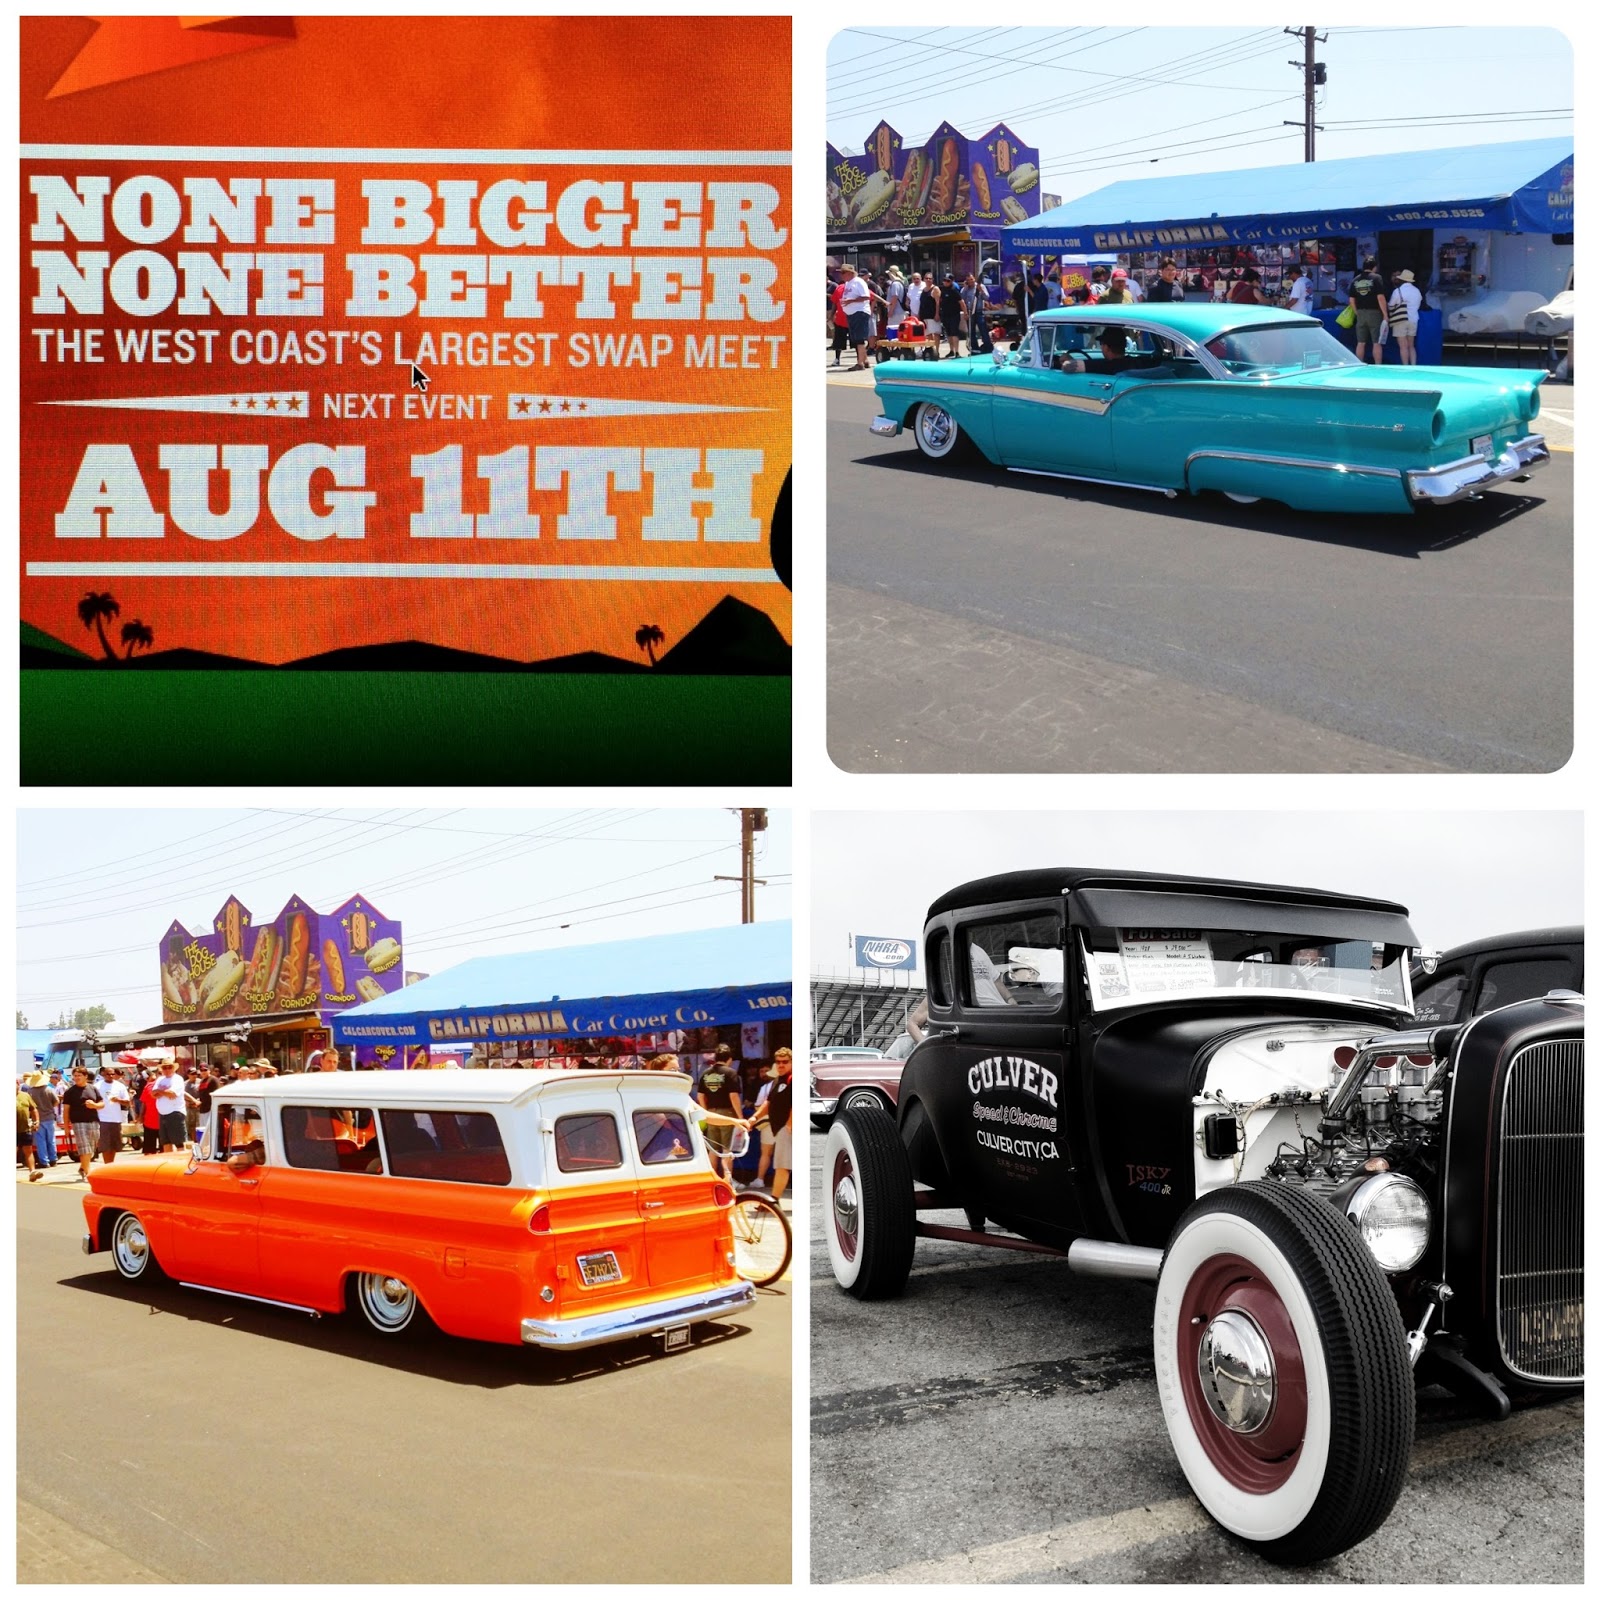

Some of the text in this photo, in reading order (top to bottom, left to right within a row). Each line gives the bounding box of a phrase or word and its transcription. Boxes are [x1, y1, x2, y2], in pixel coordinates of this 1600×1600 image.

[834, 160, 849, 177] THE
[841, 166, 859, 184] DOG
[840, 172, 868, 196] HOUSE
[29, 175, 787, 249] NONE BIGGER
[860, 201, 890, 225] KRAUTDOG
[896, 207, 926, 218] CHICAGO
[931, 209, 967, 224] CORNDOG
[973, 210, 1000, 218] CORNDOG
[1388, 208, 1485, 222] 1.800.423.5525
[834, 218, 847, 226] DOG
[903, 218, 918, 226] DOG
[1012, 237, 1081, 248] CALCARCOVER.COM
[1093, 218, 1359, 250] CALIFORNIA Car Cover Co.
[31, 250, 785, 321] NONE BETTER
[32, 329, 785, 370] THE WEST COAST'S LARGEST SWAP MEET
[323, 394, 492, 420] NEXT EVENT
[55, 443, 763, 541] AUG 11TH
[183, 939, 198, 958] THE
[190, 946, 209, 967] DOG
[863, 941, 900, 954] NHRA
[189, 952, 217, 980] HOUSE
[374, 956, 400, 973] KRAUTDOG
[209, 984, 239, 1011] KRAUTDOG
[245, 990, 275, 1002] CHICAGO
[280, 993, 317, 1008] CORNDOG
[324, 994, 356, 1002] CORNDOG
[164, 998, 196, 1014] STREET DOG
[252, 1003, 268, 1012] DOG
[342, 1026, 416, 1036] CALCARCOVER.COM
[428, 1006, 715, 1040] CALIFORNIA Car Cover Co.
[968, 1056, 1059, 1108] CULVER
[972, 1101, 1002, 1122] Speed
[1008, 1106, 1058, 1133] Chrome
[976, 1130, 1014, 1154] CULVER
[1126, 1164, 1172, 1186] ISKY
[1140, 1182, 1172, 1195] 400 JR
